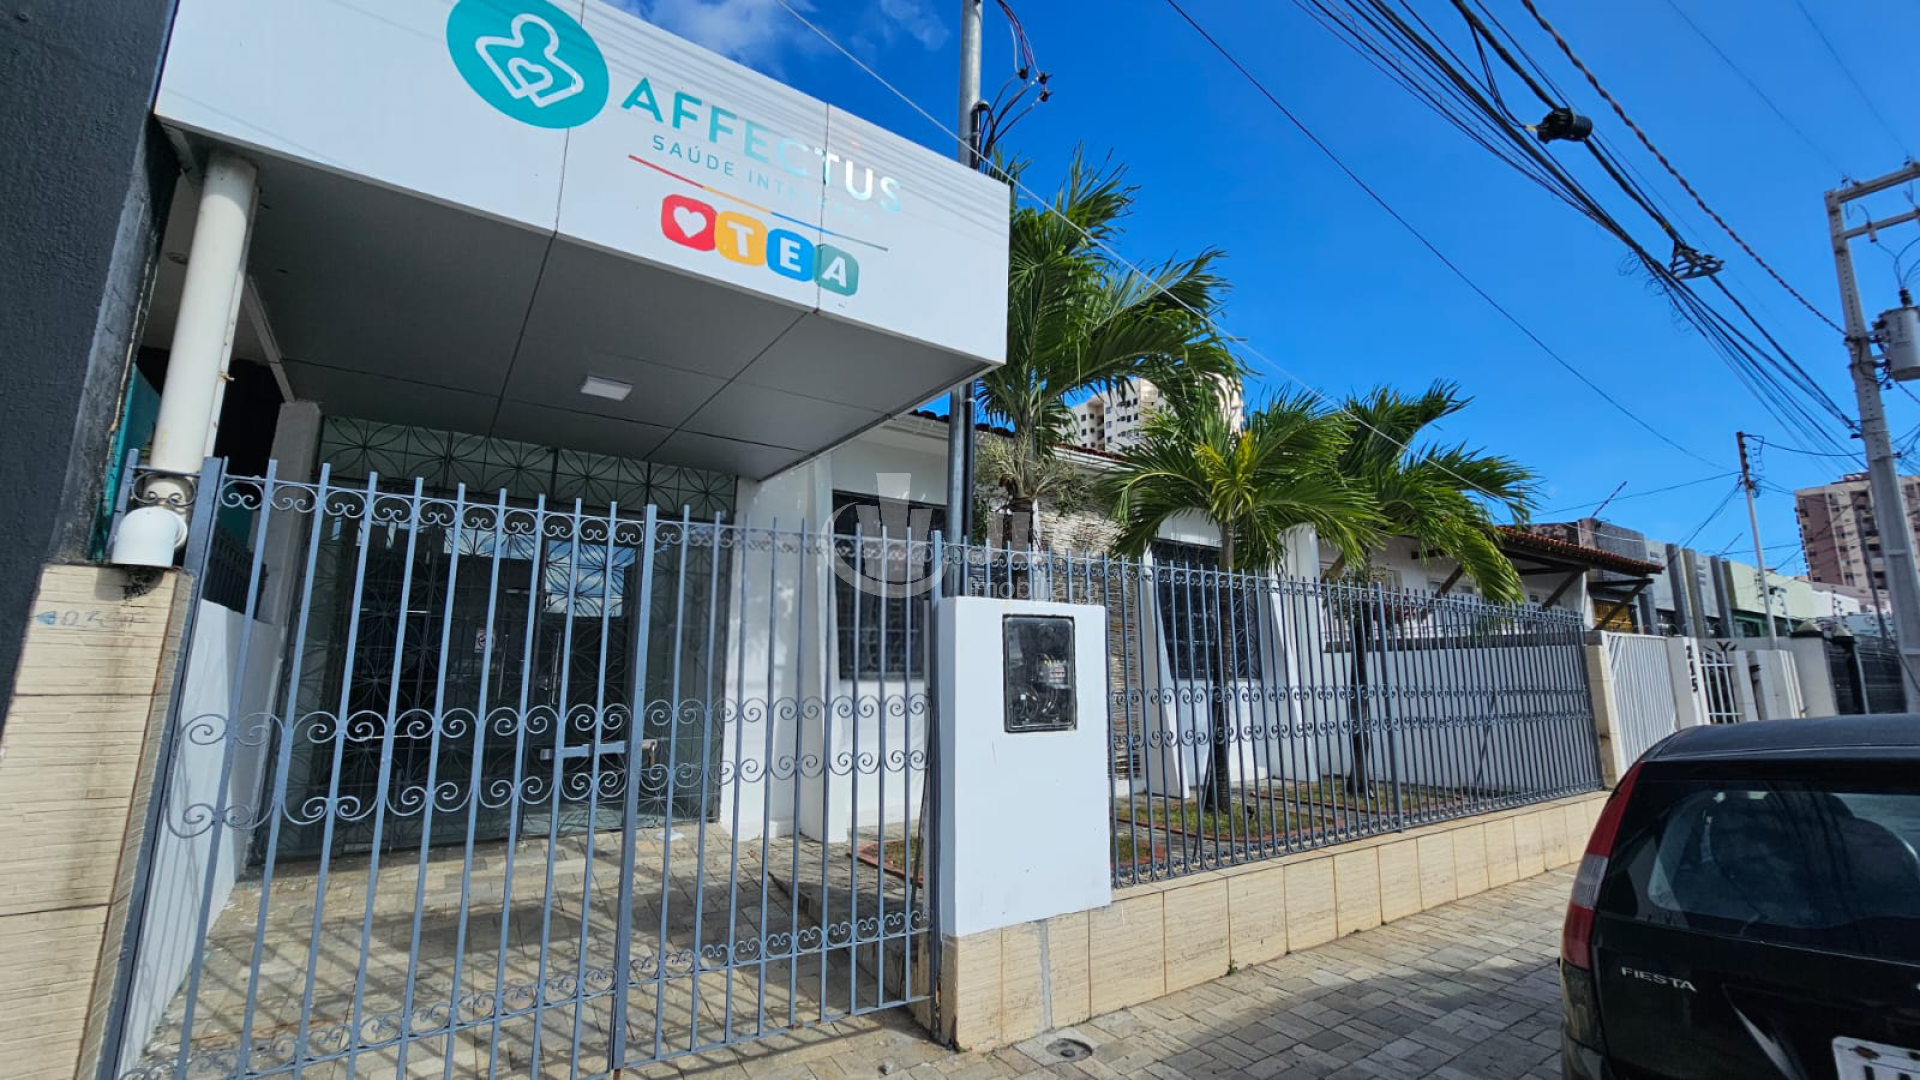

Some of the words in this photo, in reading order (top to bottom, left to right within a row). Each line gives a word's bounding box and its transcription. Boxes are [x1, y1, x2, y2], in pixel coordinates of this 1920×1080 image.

[621, 77, 901, 211] AFFECTUS
[652, 134, 735, 177] SAÚDE
[727, 220, 848, 289] TEA
[1620, 966, 1698, 992] FIESTA
